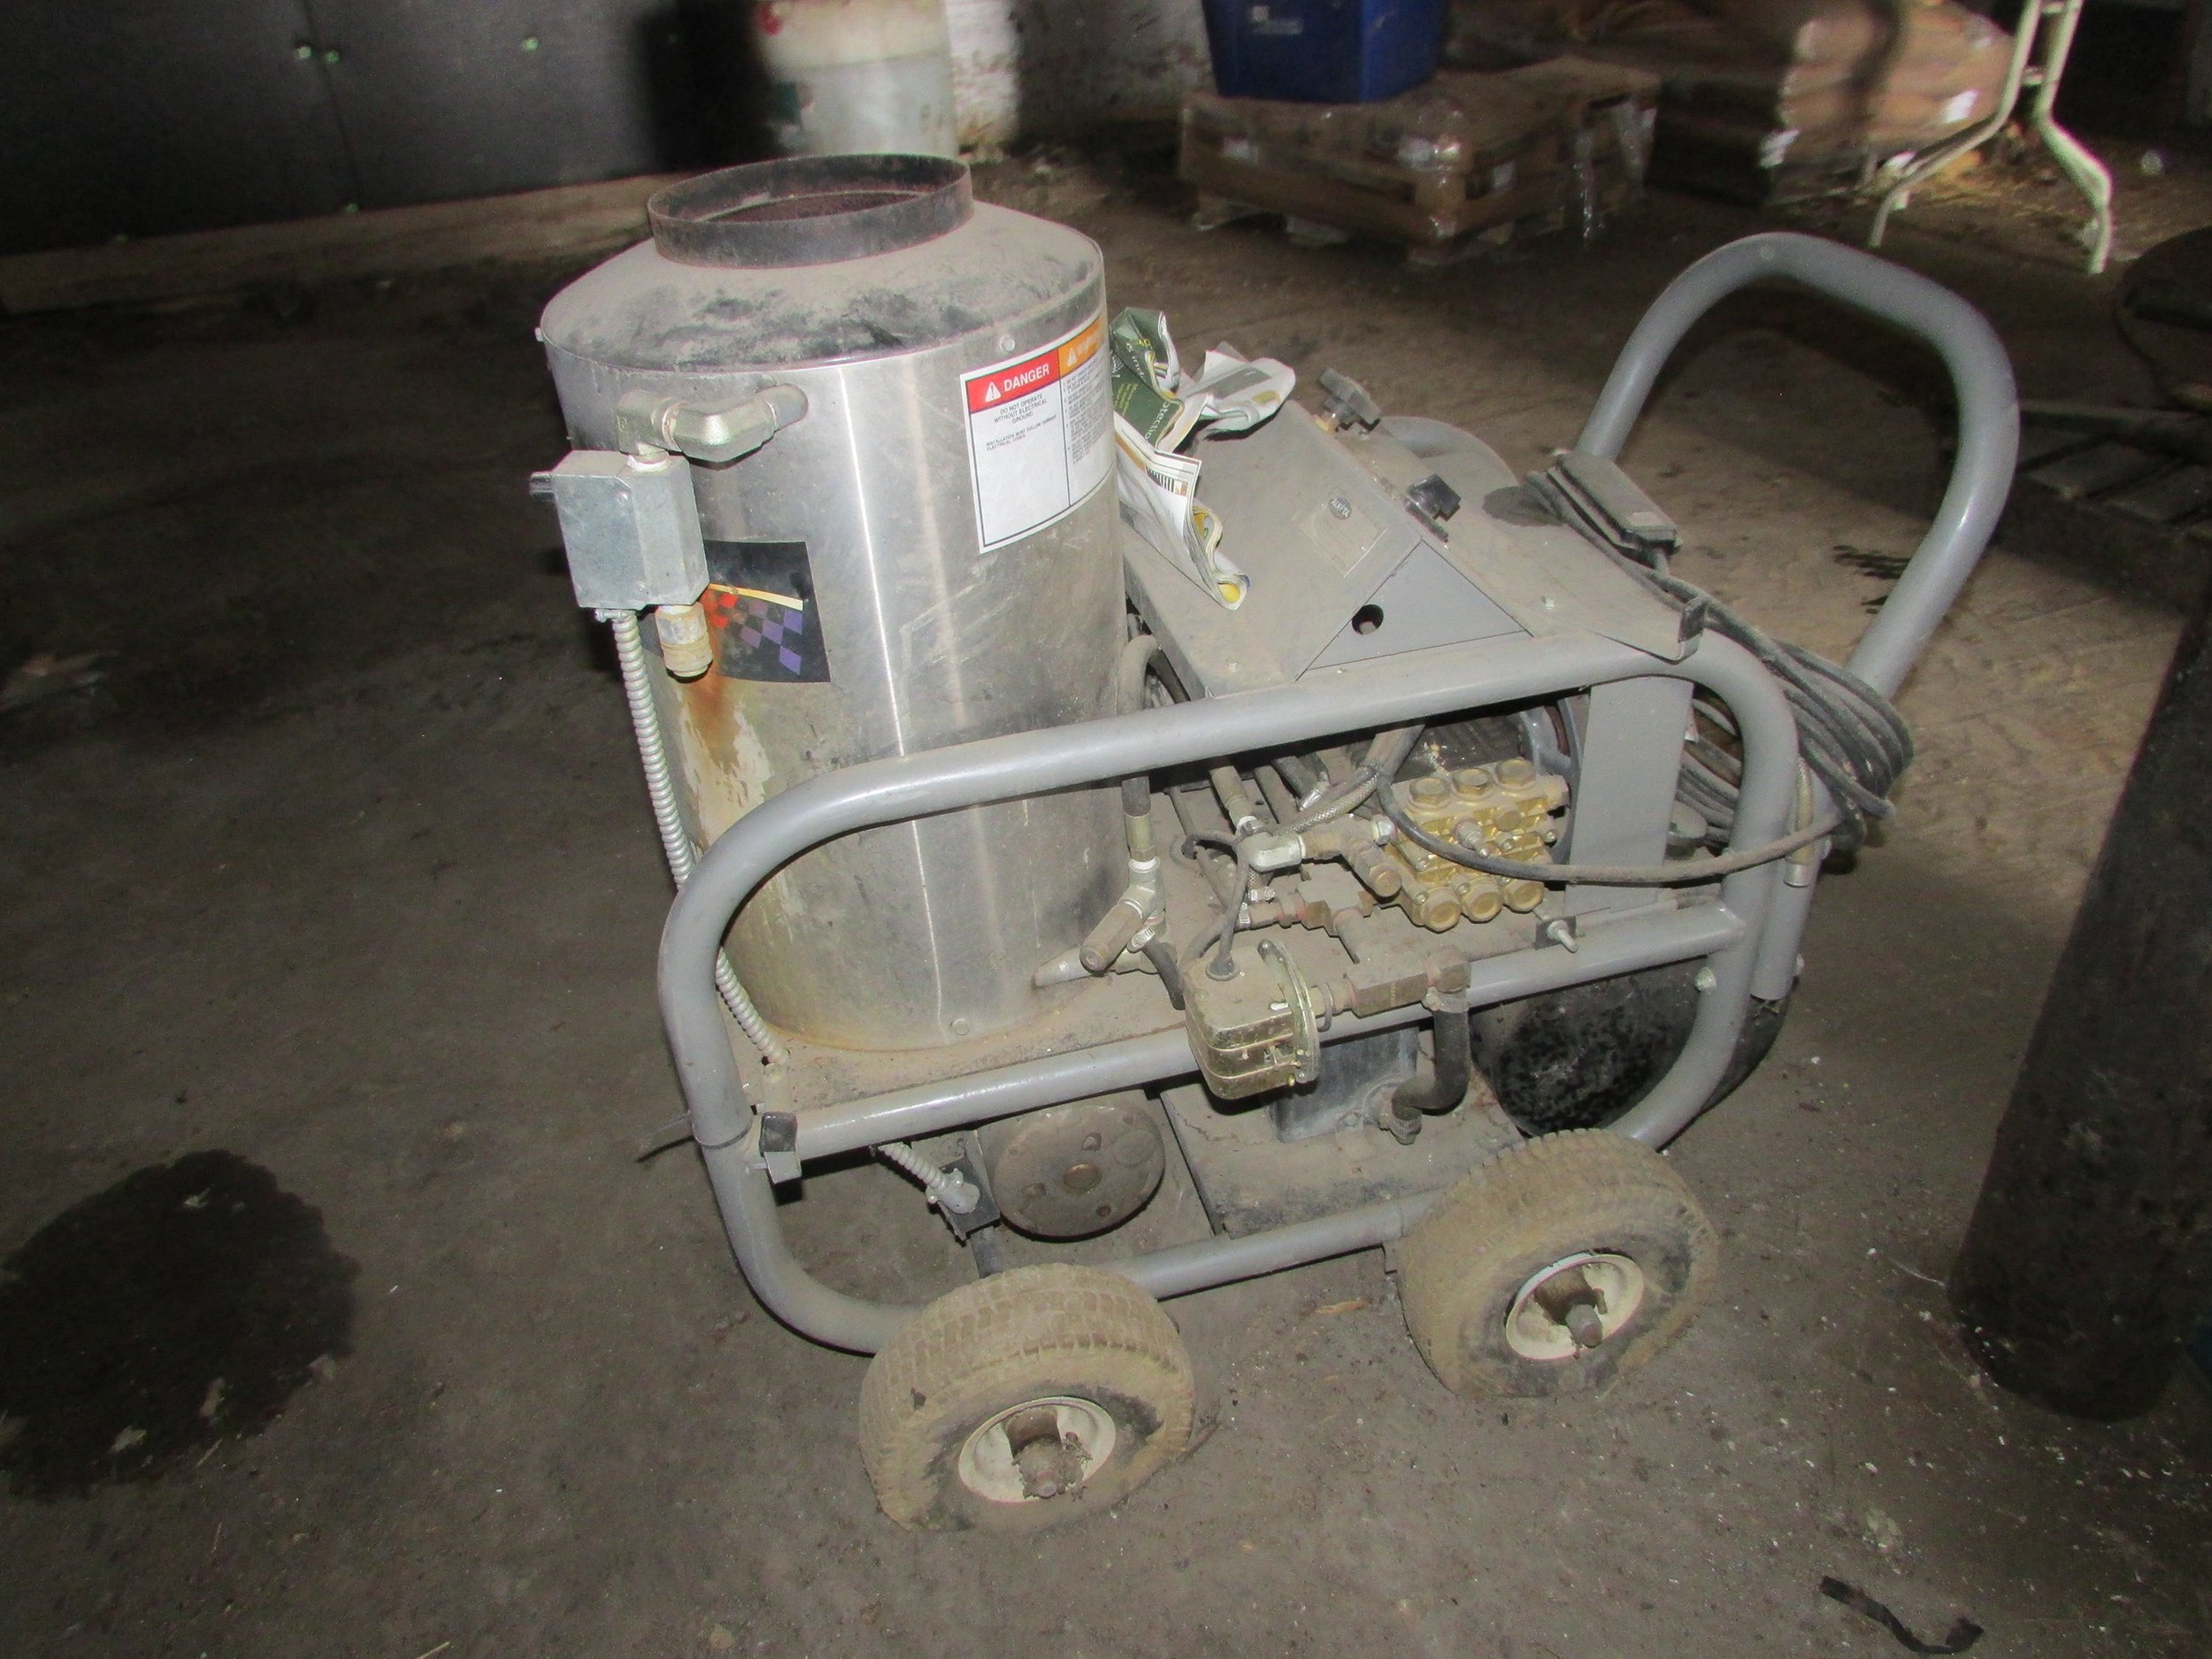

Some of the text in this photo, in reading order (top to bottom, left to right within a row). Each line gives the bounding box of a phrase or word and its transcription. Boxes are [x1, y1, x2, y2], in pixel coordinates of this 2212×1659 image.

[1003, 364, 1049, 392] DANGER
[1009, 403, 1019, 411] NOT
[1020, 394, 1042, 408] OPERATE
[994, 398, 1047, 424] WITHOUT ELECTRICAL
[1012, 411, 1033, 424] GROUND
[987, 433, 1014, 446] INSTALLATION
[987, 440, 1010, 451] ELECTRICAL
